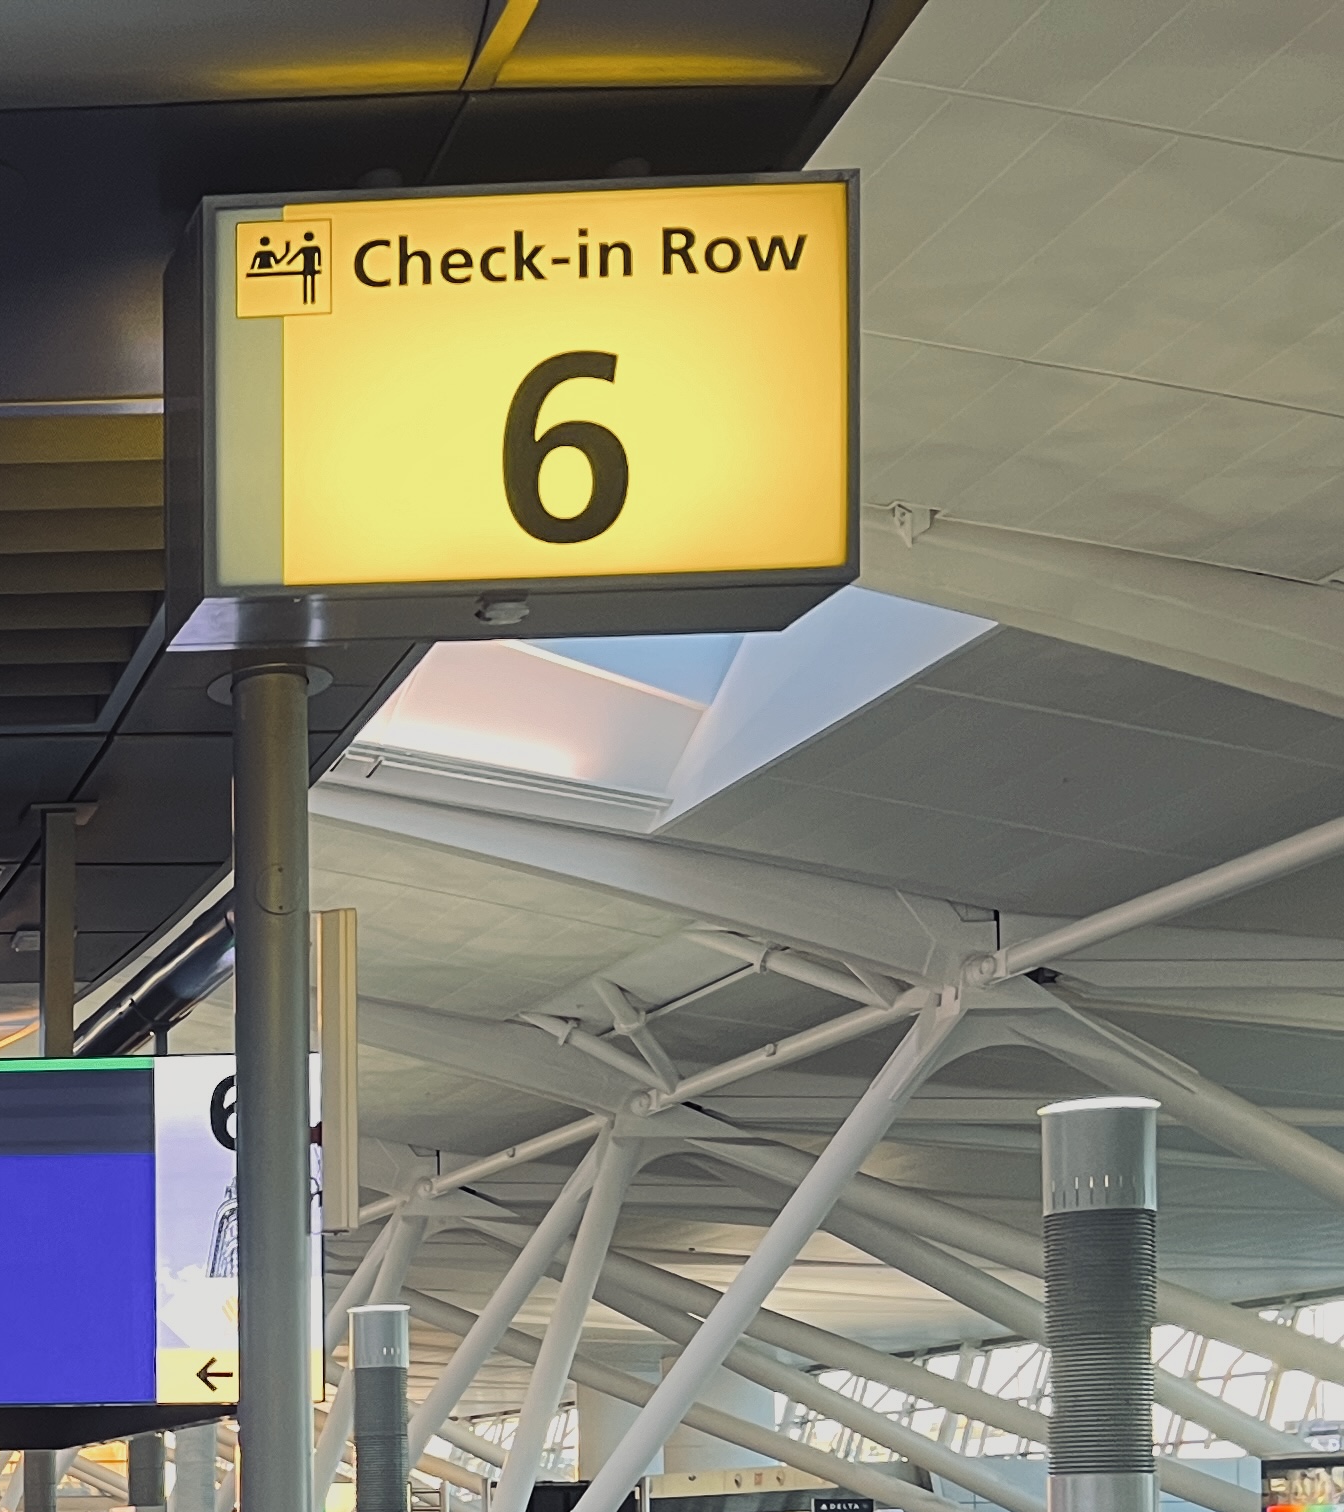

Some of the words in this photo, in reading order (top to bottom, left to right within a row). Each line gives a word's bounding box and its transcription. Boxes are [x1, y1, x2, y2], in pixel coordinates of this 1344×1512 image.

[353, 228, 634, 288] Check-in
[662, 227, 808, 275] Row
[502, 349, 630, 544] 6
